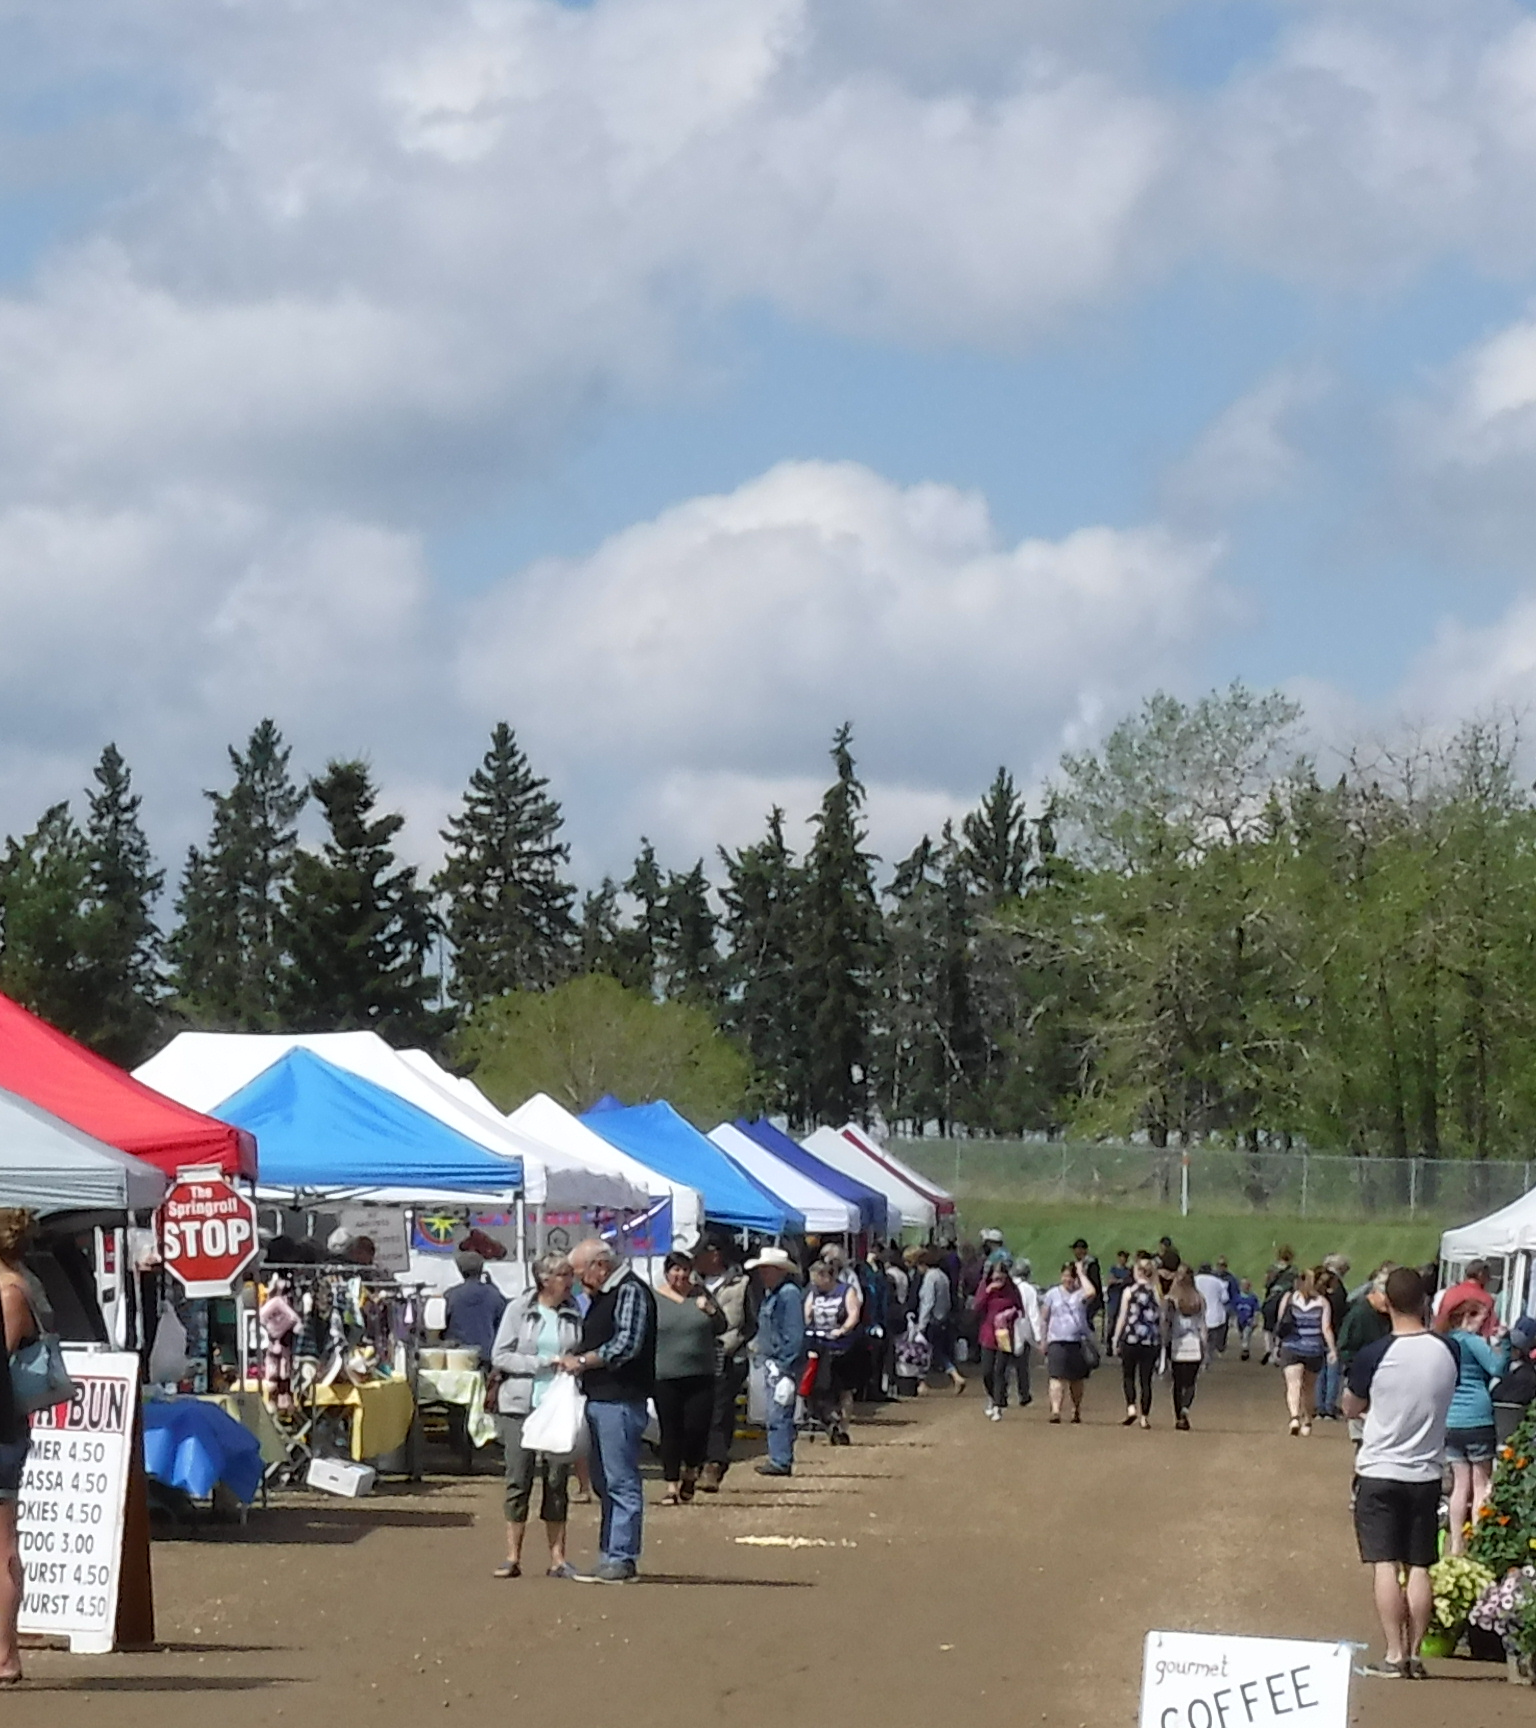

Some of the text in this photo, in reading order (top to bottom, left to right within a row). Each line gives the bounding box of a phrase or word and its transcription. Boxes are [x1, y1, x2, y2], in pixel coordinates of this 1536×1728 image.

[189, 1185, 213, 1200] The
[168, 1197, 238, 1219] Springroll
[164, 1219, 251, 1260] STOP
[66, 1381, 127, 1431] BUN
[68, 1442, 105, 1462] 4.50
[71, 1472, 107, 1493] 4.50
[66, 1502, 102, 1524] 4.50
[61, 1532, 94, 1554] 3.00
[24, 1562, 109, 1586] URST 4.50
[76, 1595, 106, 1617] 4.50
[1155, 1654, 1229, 1685] gourmet
